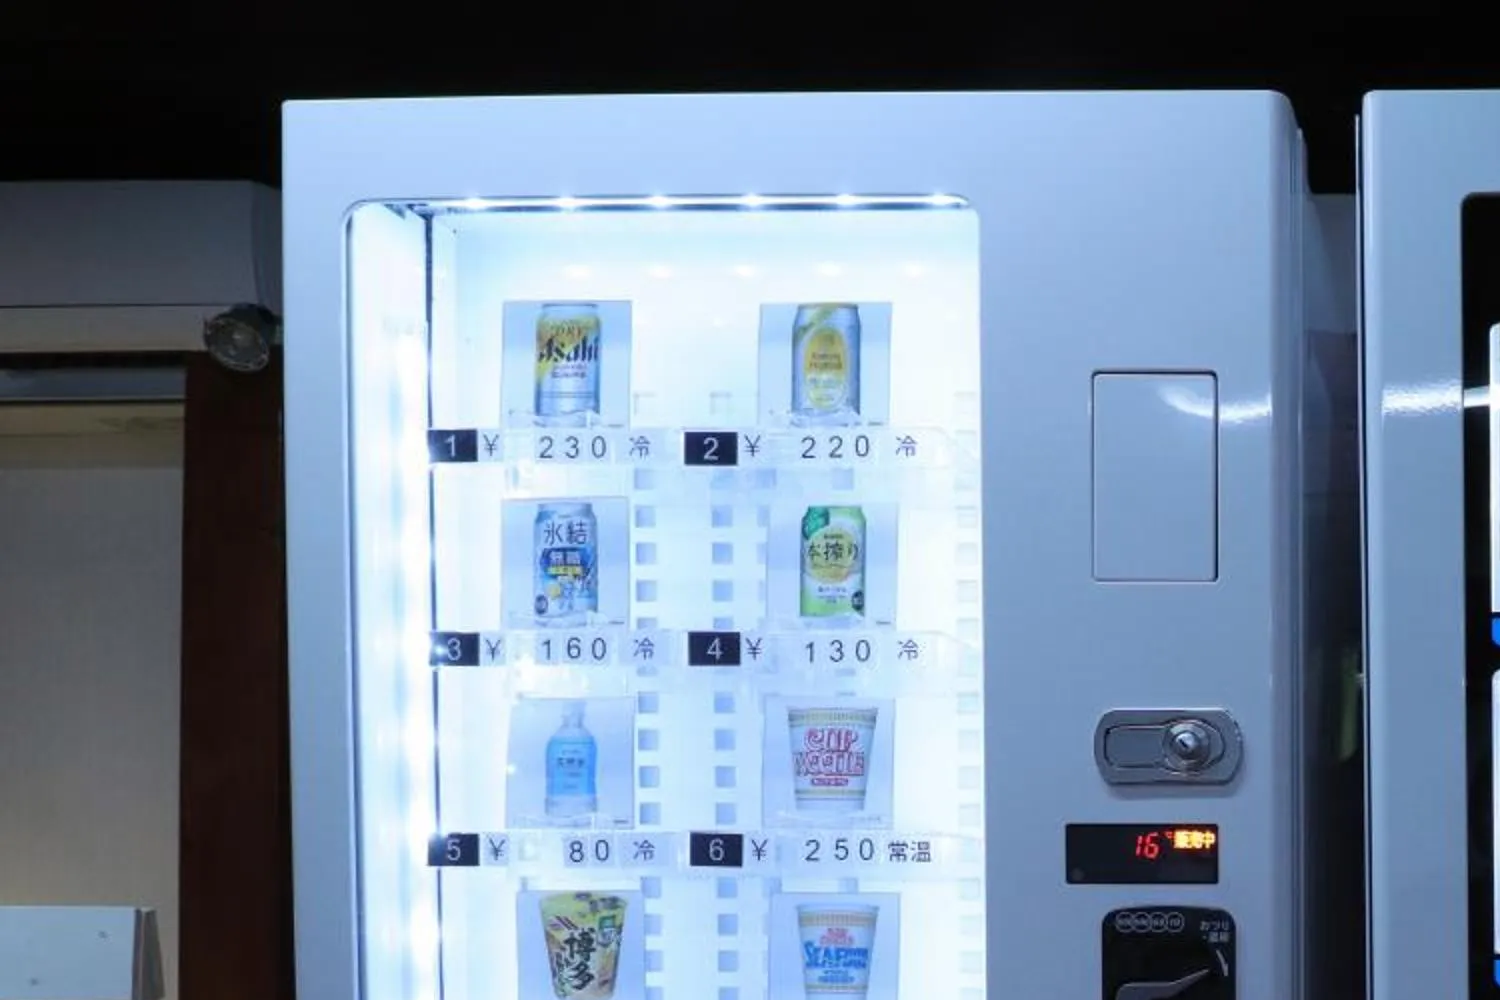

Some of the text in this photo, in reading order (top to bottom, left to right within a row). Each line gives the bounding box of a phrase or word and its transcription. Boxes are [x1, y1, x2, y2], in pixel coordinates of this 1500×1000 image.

[446, 435, 651, 459] 1 ¥ 230 冷
[703, 435, 917, 460] 2 ¥ 220 冷
[543, 520, 587, 546] 氷結
[485, 638, 502, 659] ¥
[541, 638, 608, 660] 160
[633, 639, 655, 661] 冷
[706, 638, 918, 663] 4 ¥ 130 冷
[446, 838, 655, 863] 5 ¥ 80 冷
[708, 838, 933, 864] 6 ¥ 250 常温
[563, 927, 597, 990] 博多
